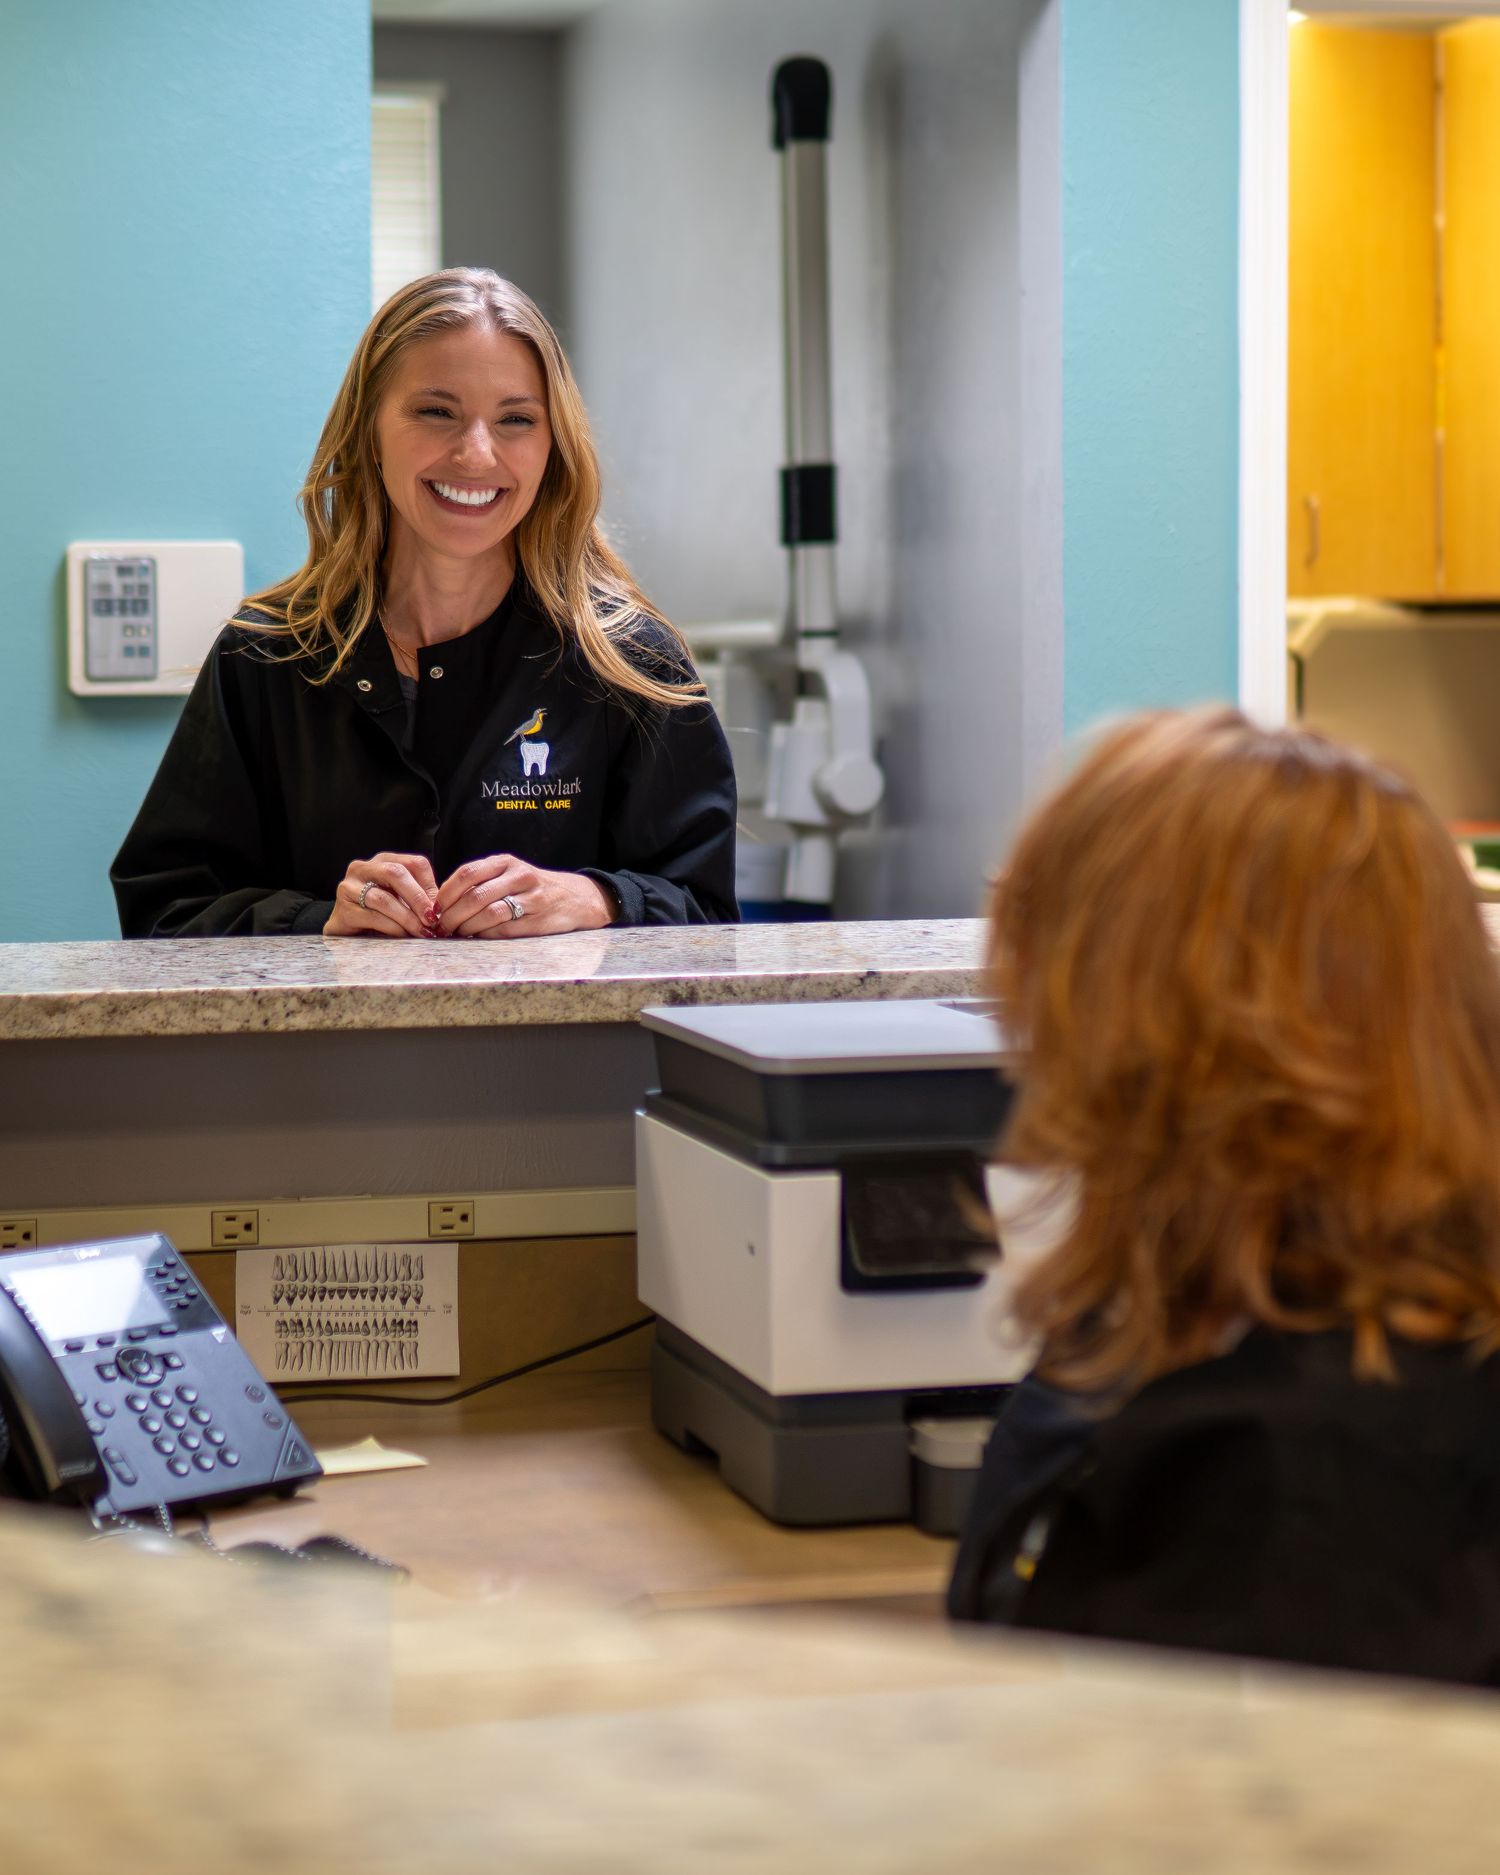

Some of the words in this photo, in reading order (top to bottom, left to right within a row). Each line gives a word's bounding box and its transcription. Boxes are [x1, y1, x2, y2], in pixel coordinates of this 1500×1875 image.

[481, 777, 581, 798] Meadowlark
[496, 800, 538, 810] DENTAL
[545, 799, 571, 809] CARE
